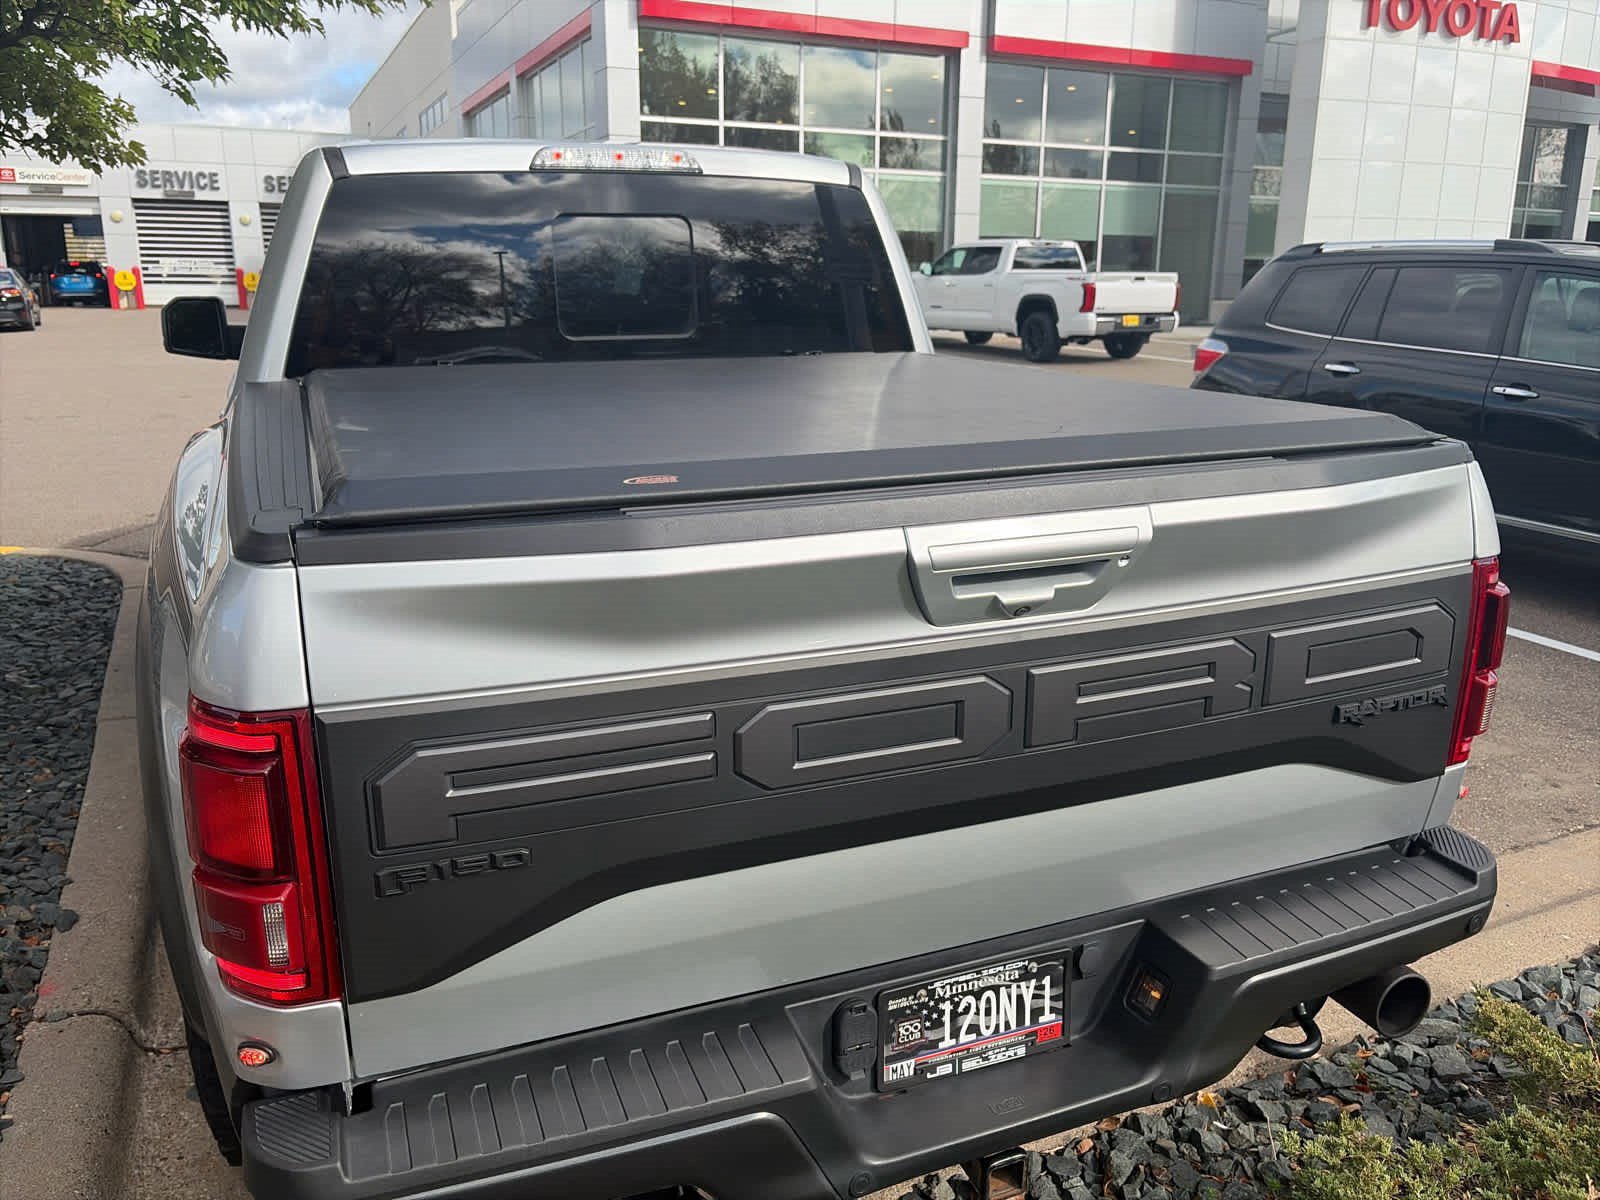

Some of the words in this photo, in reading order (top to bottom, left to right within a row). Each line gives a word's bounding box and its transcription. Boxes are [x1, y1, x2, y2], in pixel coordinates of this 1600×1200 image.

[1367, 0, 1521, 43] TOYOTA
[18, 171, 88, 182] ServiceCenter
[135, 169, 221, 191] SERVICE
[1333, 684, 1448, 727] RAPTOR
[371, 603, 1453, 850] FORD
[934, 968, 1020, 999] Minnesota
[939, 976, 1056, 1049] 120NY1
[898, 1022, 921, 1037] 100
[898, 1032, 921, 1043] CLUB
[889, 1059, 915, 1081] MAY
